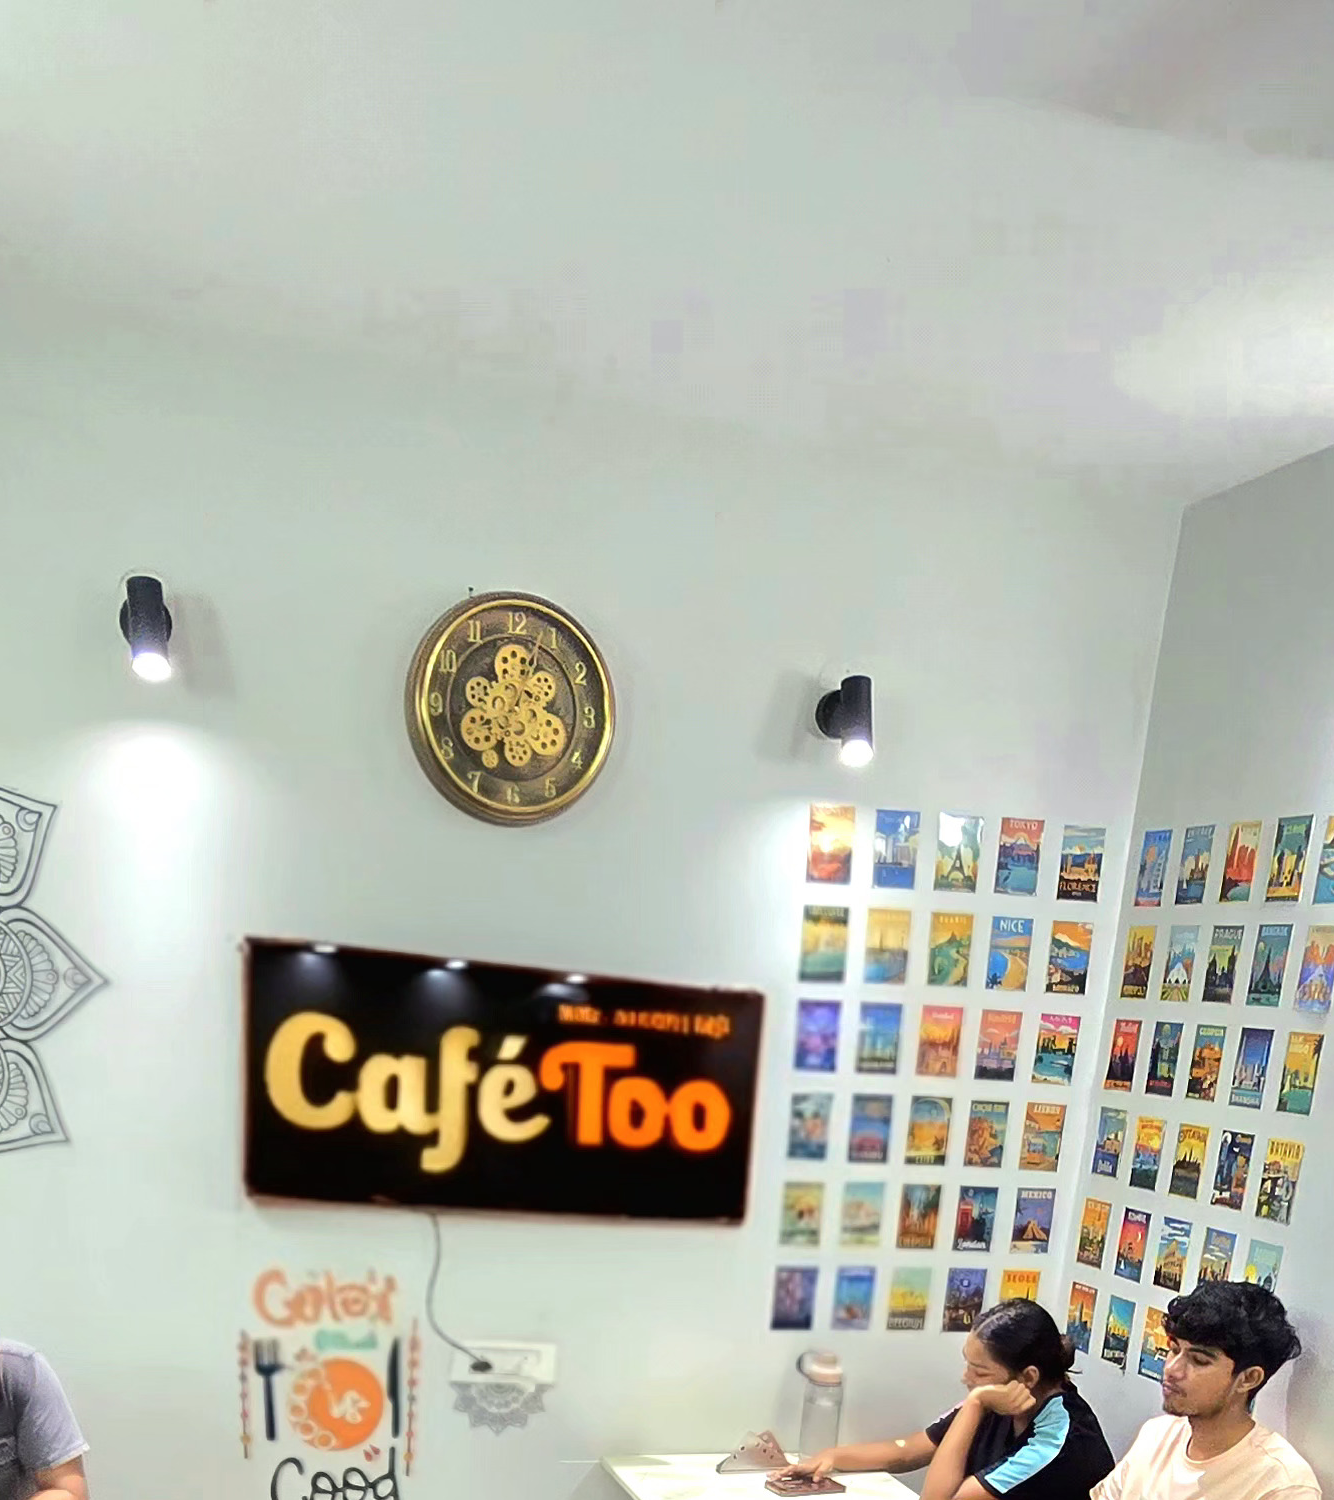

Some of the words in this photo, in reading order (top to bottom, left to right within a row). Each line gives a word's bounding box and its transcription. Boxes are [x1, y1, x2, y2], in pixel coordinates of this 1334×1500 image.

[468, 620, 483, 644] 11
[508, 611, 527, 635] 12
[550, 628, 558, 649] 1
[439, 650, 457, 673] 10
[575, 661, 587, 686] 2
[430, 692, 443, 716] 9
[583, 706, 595, 728] 3
[442, 737, 454, 760] 8
[571, 751, 583, 771] 4
[467, 771, 482, 794] 7
[545, 777, 556, 798] 5
[507, 785, 520, 804] 6
[1010, 819, 1038, 831] TOKYO
[999, 919, 1025, 933] NICE
[265, 1011, 552, 1174] Café
[538, 1040, 733, 1153] Too
[1020, 1189, 1053, 1200] MEXICO
